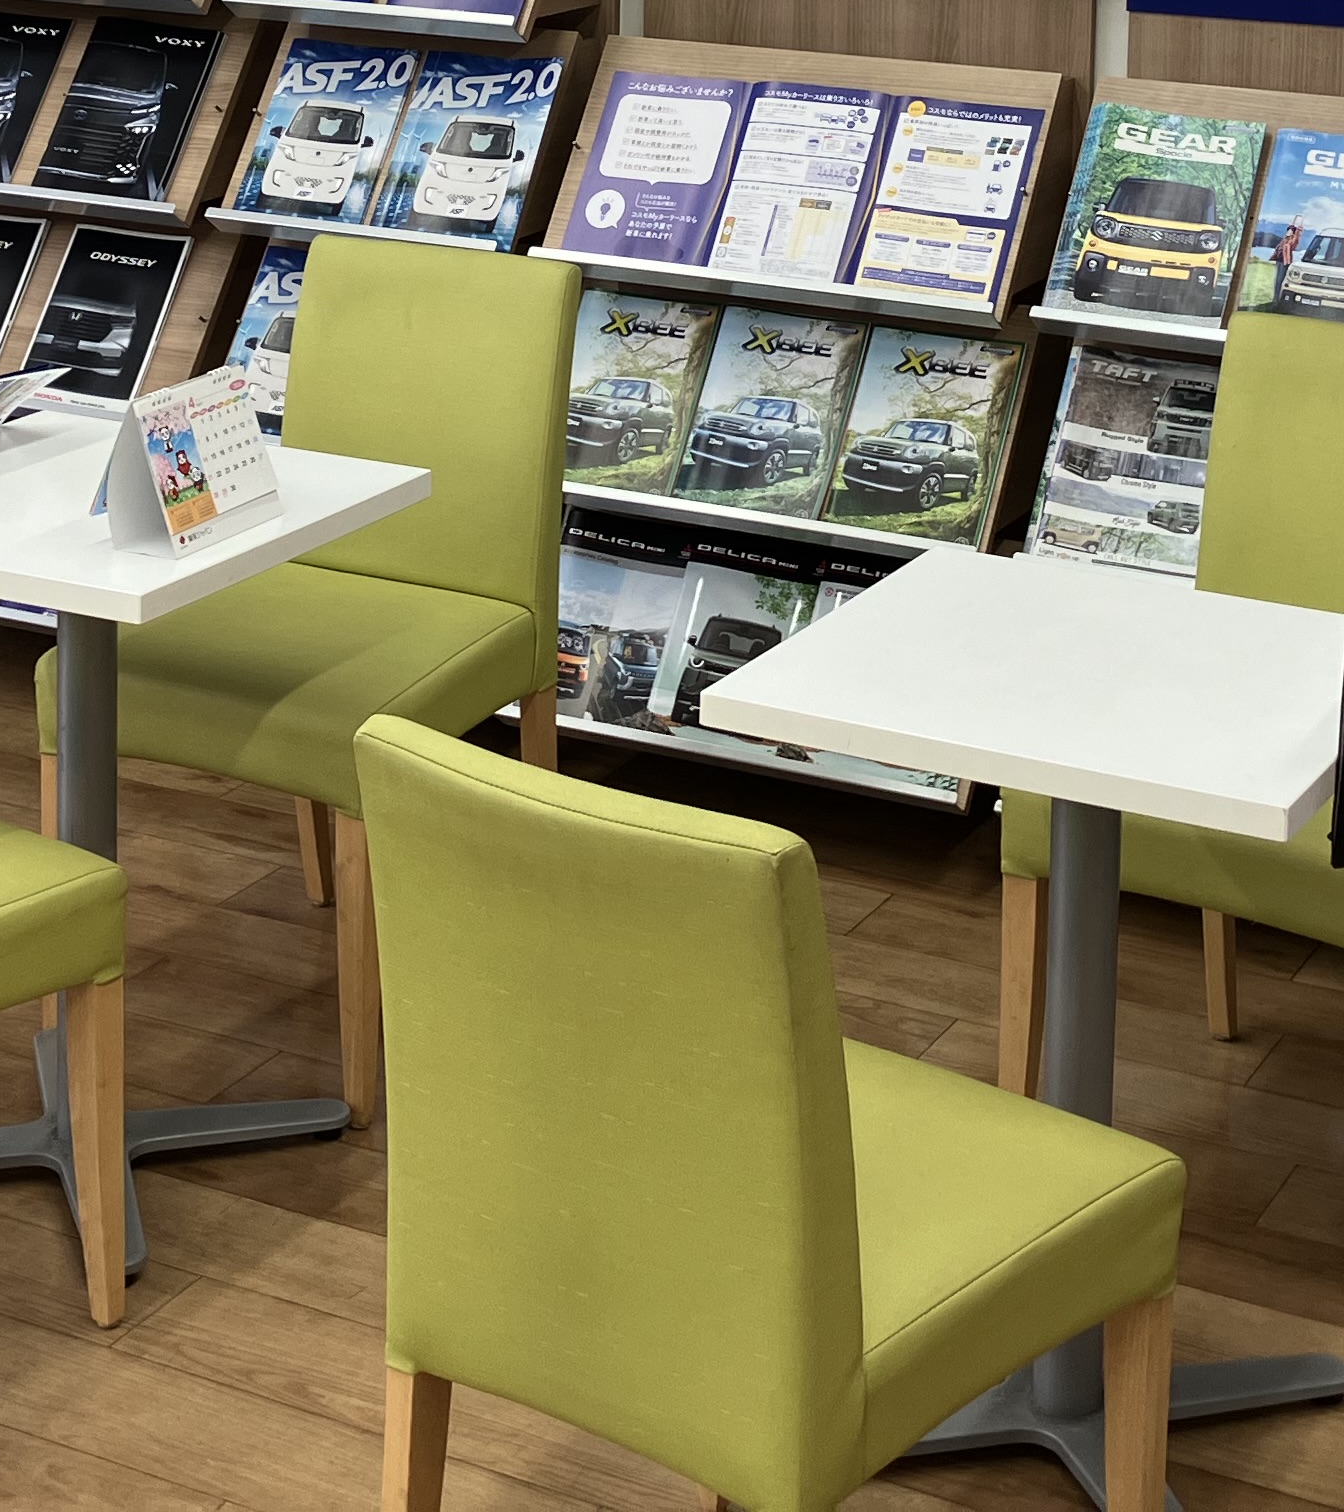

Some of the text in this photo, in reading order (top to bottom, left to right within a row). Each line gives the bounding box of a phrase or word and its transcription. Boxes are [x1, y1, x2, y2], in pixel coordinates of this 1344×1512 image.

[12, 25, 60, 37] VOXY
[154, 35, 206, 49] VOXY
[274, 55, 417, 96] ASF 2.0
[409, 62, 562, 110] ASF 2.0
[1117, 122, 1237, 156] GEAR
[90, 250, 157, 268] ODYSSEY
[1091, 360, 1157, 383] TAFT
[568, 526, 645, 550] DELICA
[697, 543, 777, 566] DELICA
